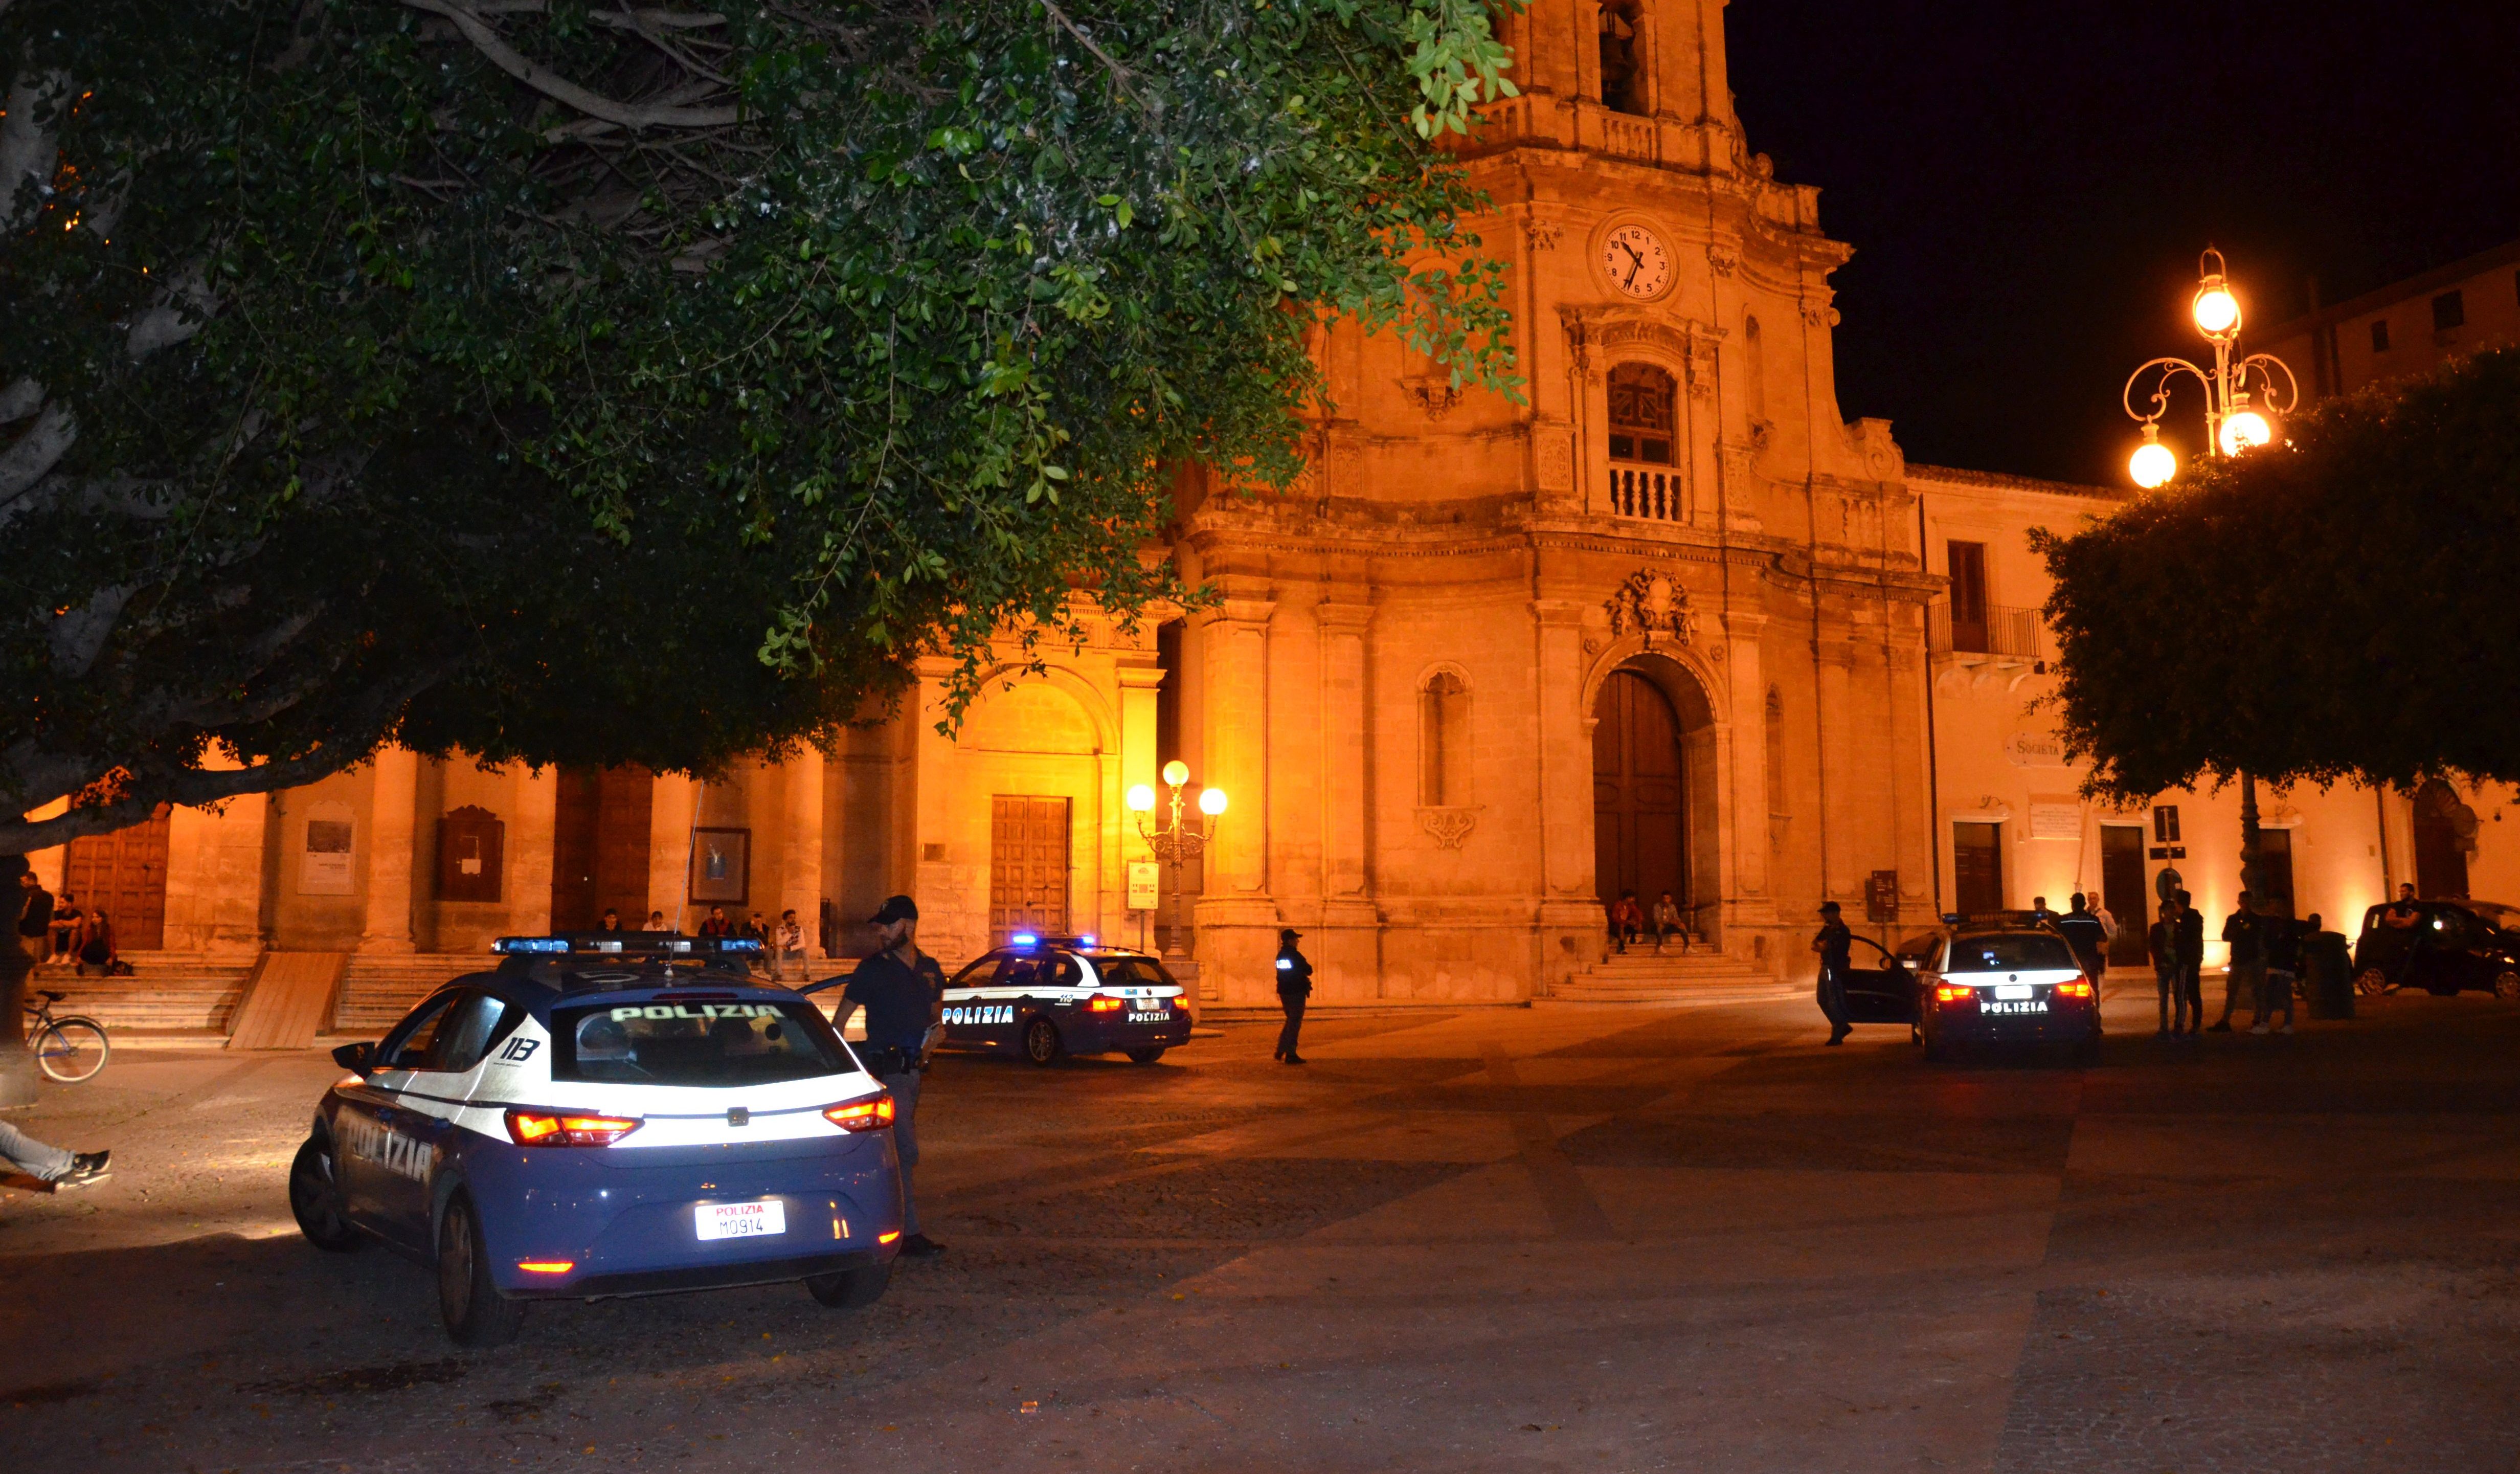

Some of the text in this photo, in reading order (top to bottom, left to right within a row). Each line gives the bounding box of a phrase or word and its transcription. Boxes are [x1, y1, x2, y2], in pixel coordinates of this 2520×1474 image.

[1619, 232, 1626, 241] 11
[1631, 231, 1640, 239] 12
[1611, 240, 1618, 249] 10
[1655, 247, 1661, 255] 2
[1607, 253, 1612, 261] 9
[1659, 262, 1666, 270] 3
[1612, 268, 1617, 276] 8
[1655, 275, 1661, 283] 4
[1635, 285, 1640, 293] 6
[1647, 283, 1652, 292] 5
[1060, 994, 1073, 1003] 113
[1981, 1001, 2048, 1013] POLIZIA
[611, 1004, 784, 1022] POLIZIA
[942, 1006, 1013, 1024] POLIZIA
[1129, 1013, 1170, 1022] POLIZIA
[500, 1037, 541, 1062] 113
[716, 1204, 764, 1216] POLIZIA
[719, 1218, 763, 1235] M0914
